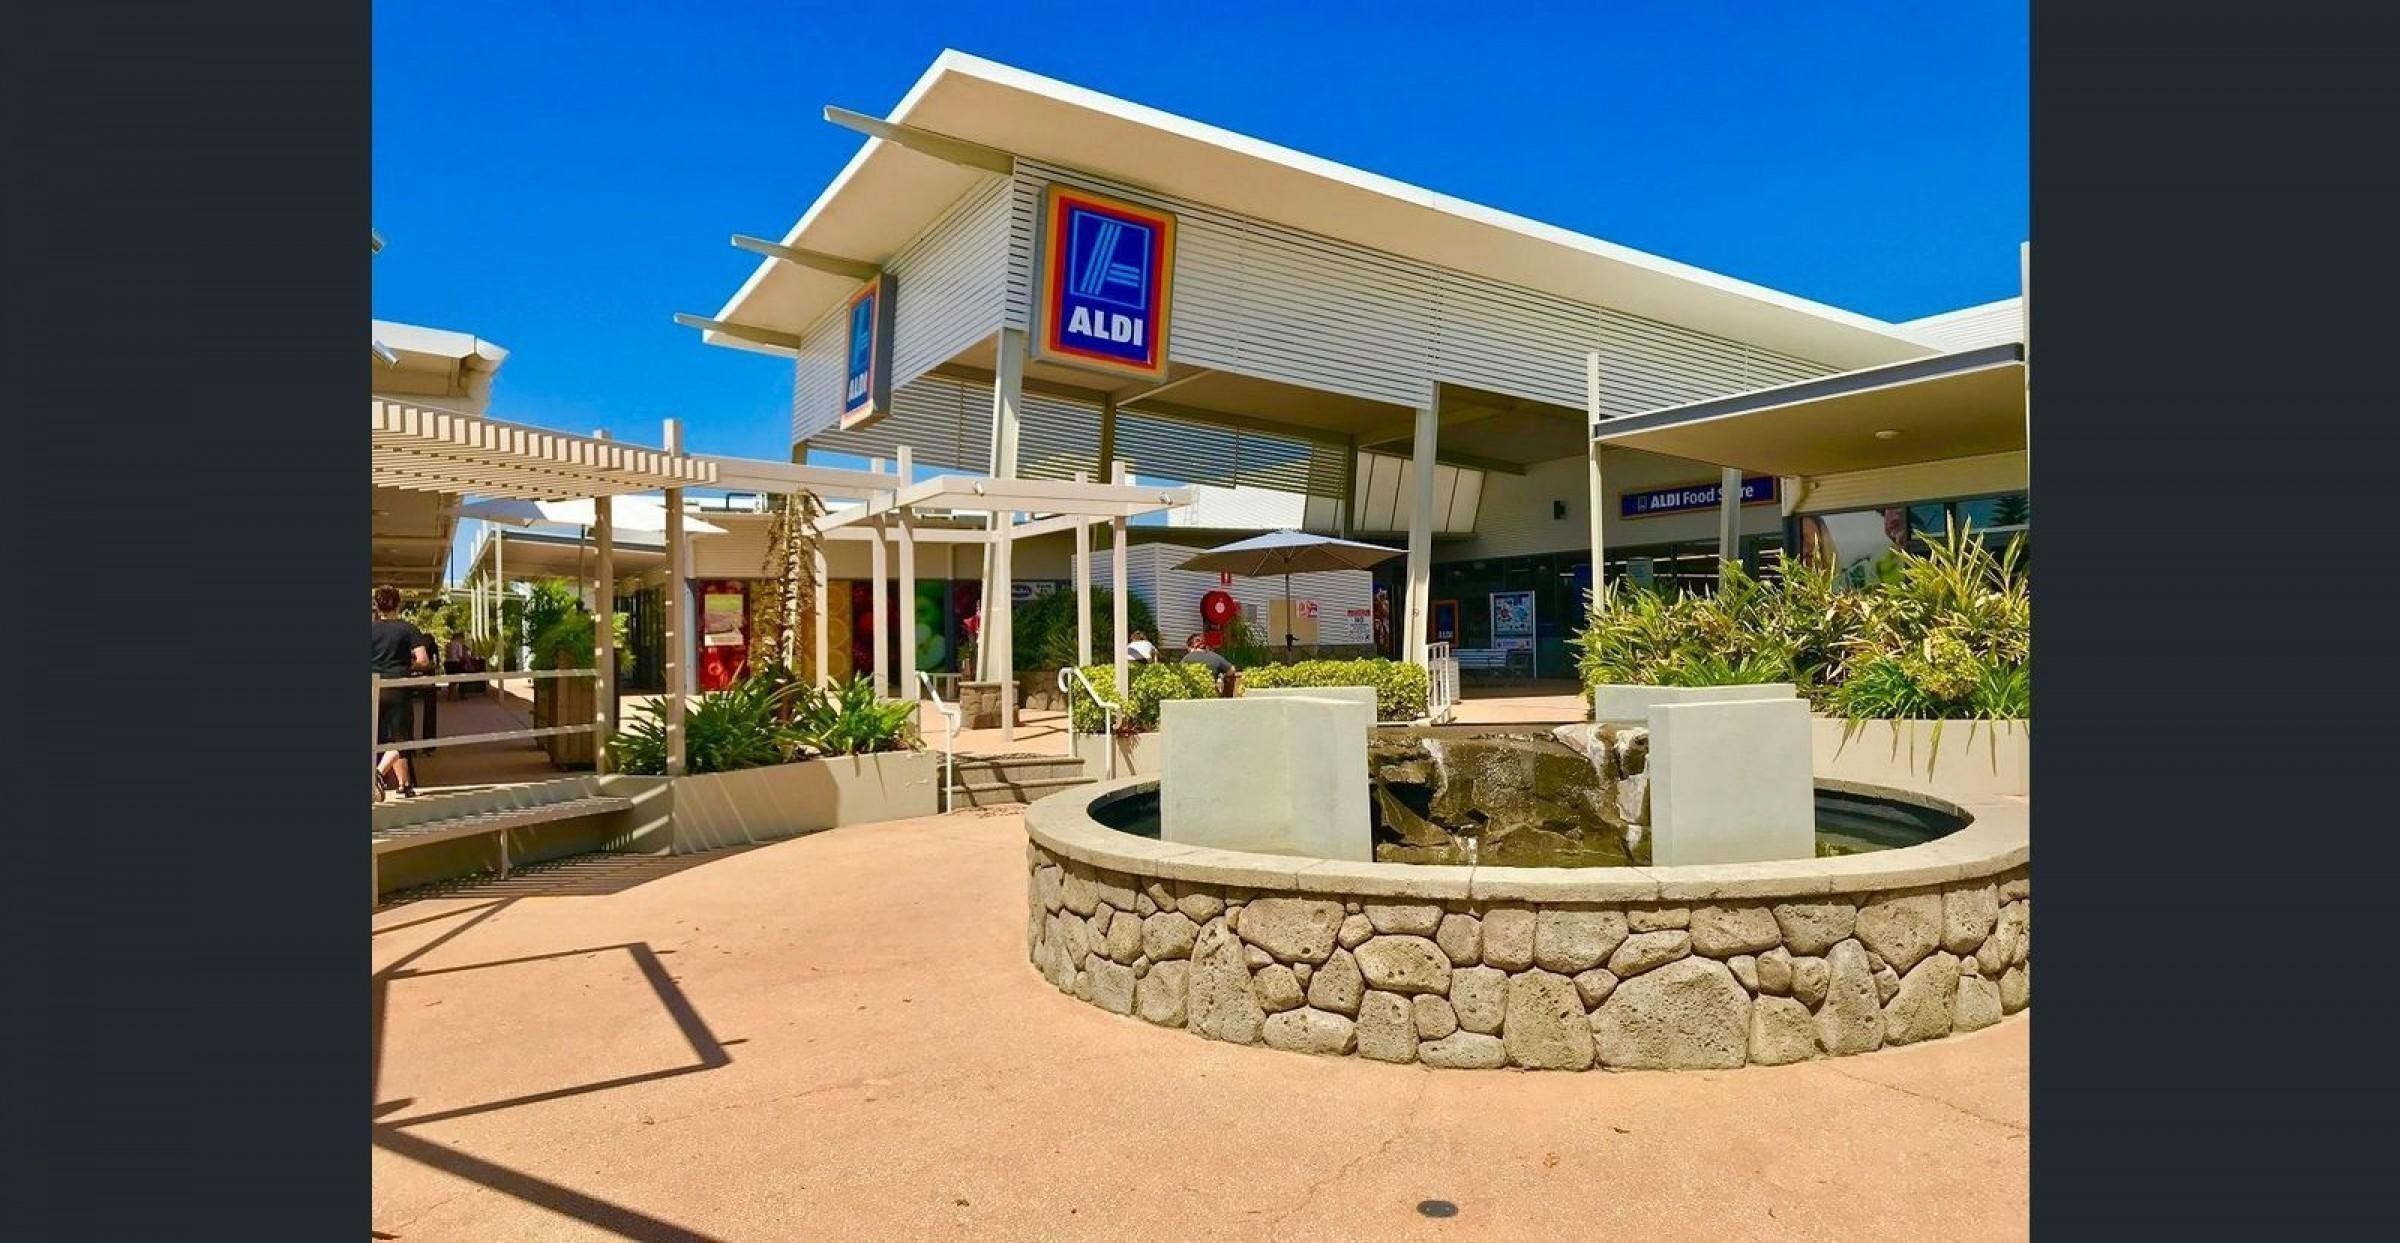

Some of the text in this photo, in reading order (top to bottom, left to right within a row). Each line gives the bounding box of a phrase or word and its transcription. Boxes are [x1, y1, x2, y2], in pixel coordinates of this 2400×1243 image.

[1068, 305, 1143, 346] ALDI
[1650, 486, 1754, 509] ALDI Food Sre
